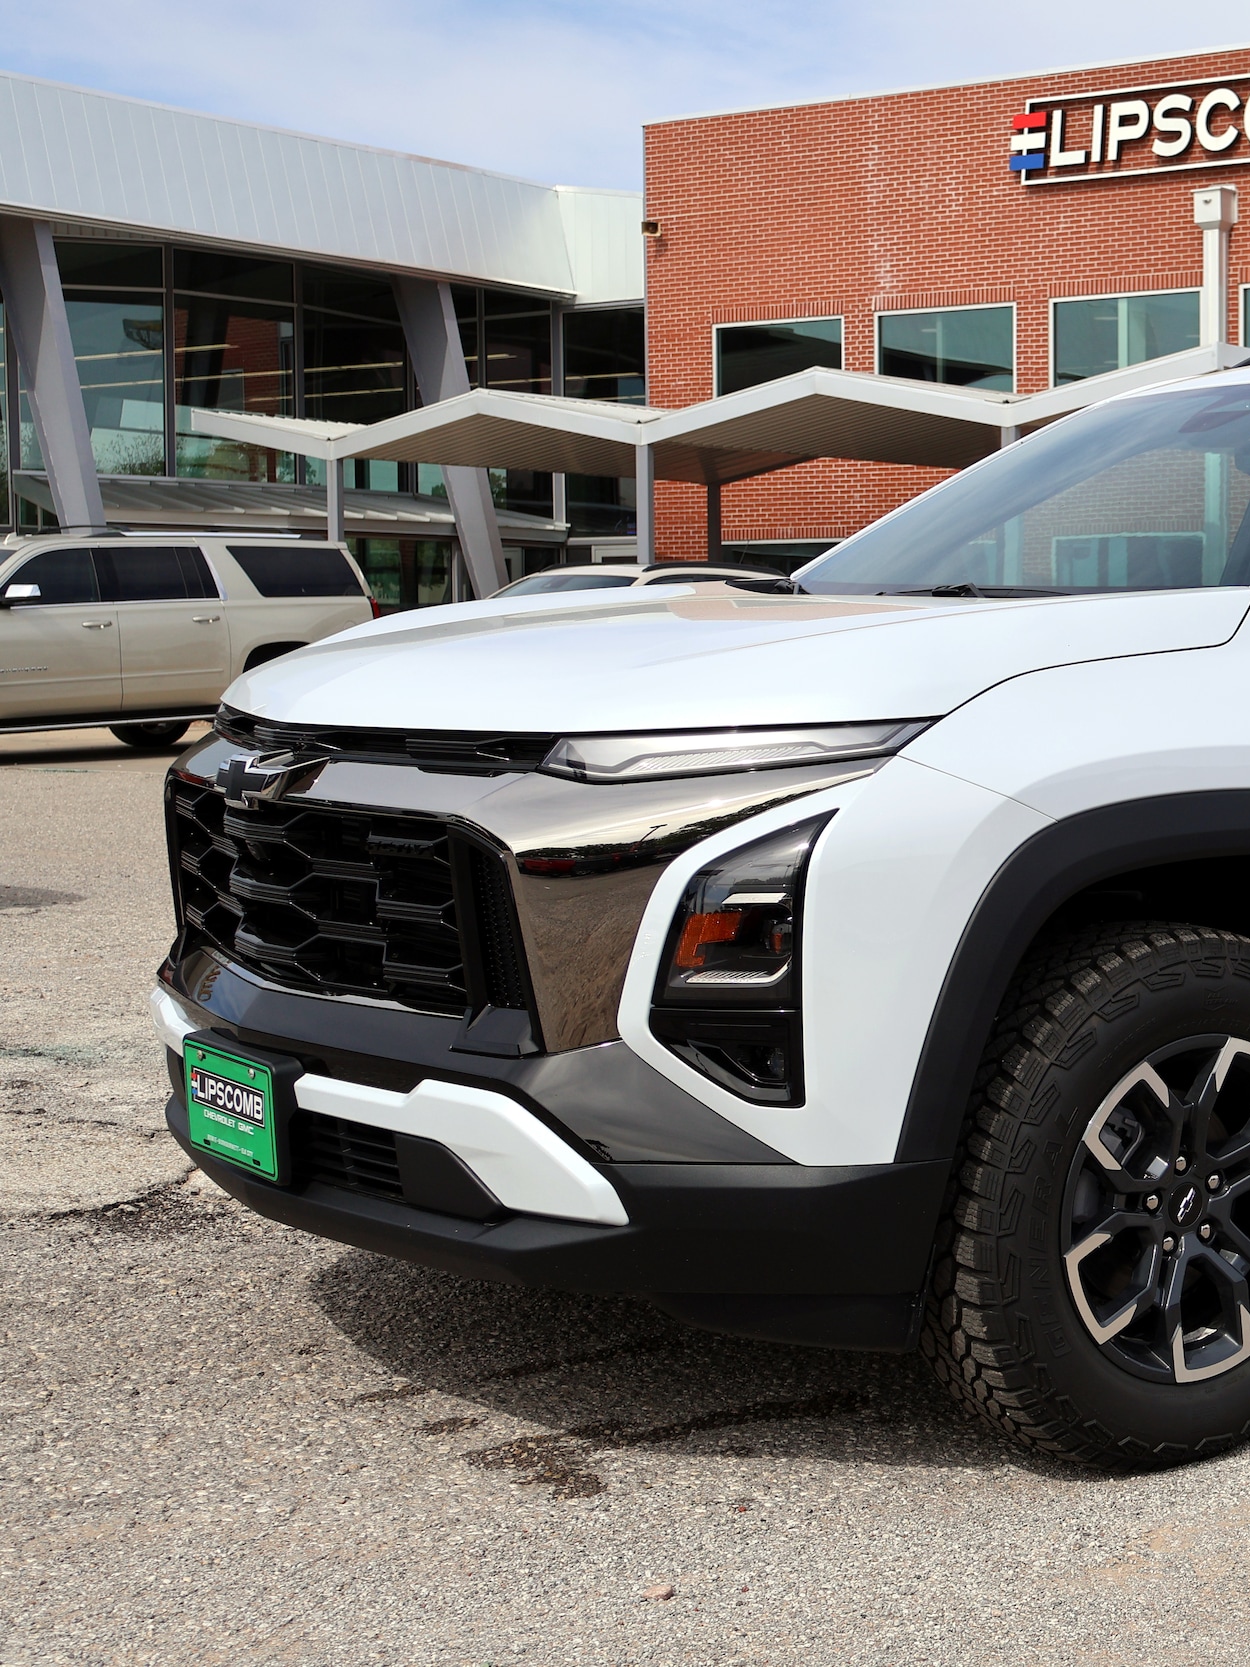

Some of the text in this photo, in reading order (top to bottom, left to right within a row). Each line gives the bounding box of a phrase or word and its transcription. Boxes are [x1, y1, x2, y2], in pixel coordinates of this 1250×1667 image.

[197, 1074, 263, 1120] LIPSCOMB
[204, 1109, 254, 1135] CHEVROLET GMC
